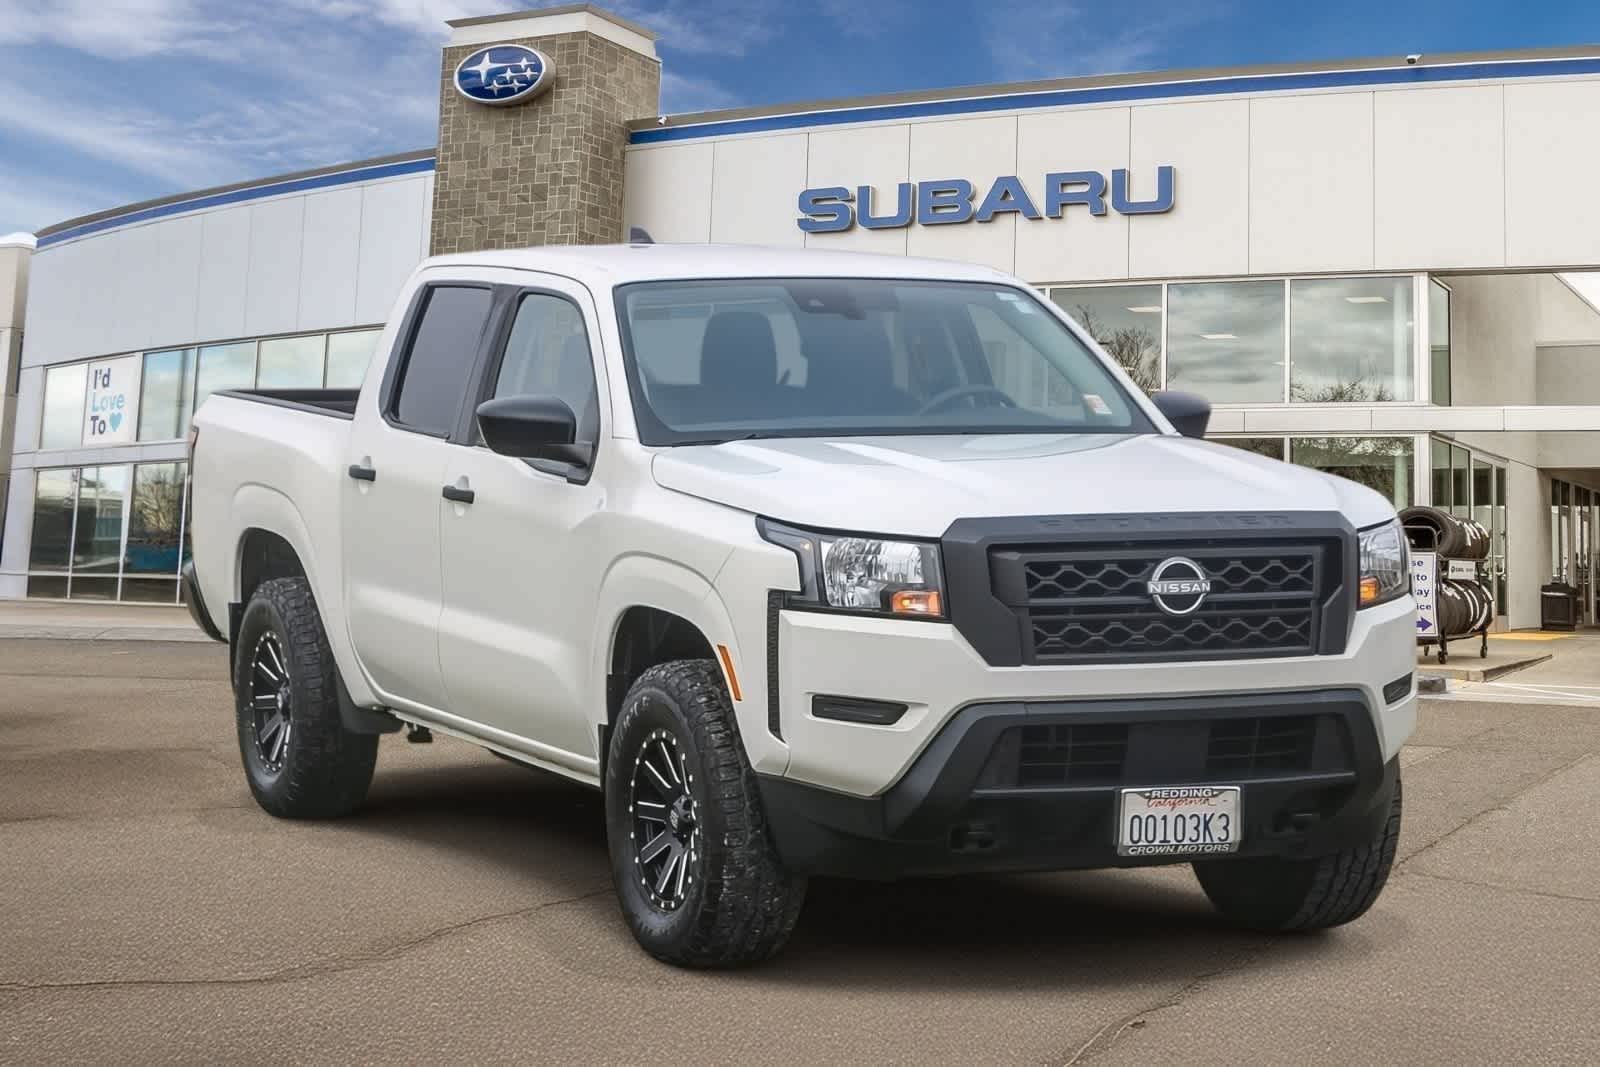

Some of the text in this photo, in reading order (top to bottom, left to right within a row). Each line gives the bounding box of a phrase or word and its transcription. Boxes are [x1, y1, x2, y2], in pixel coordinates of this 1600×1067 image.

[797, 165, 1176, 233] SUBARU
[94, 367, 111, 389] I'd
[92, 392, 125, 412] Love
[90, 415, 106, 435] To
[1414, 573, 1428, 581] to
[1149, 581, 1211, 593] NISSAN
[1415, 588, 1430, 598] ay
[1151, 788, 1213, 798] REDDING
[1129, 812, 1230, 844] 00103K3
[1128, 843, 1230, 855] CROWN MOTORS
